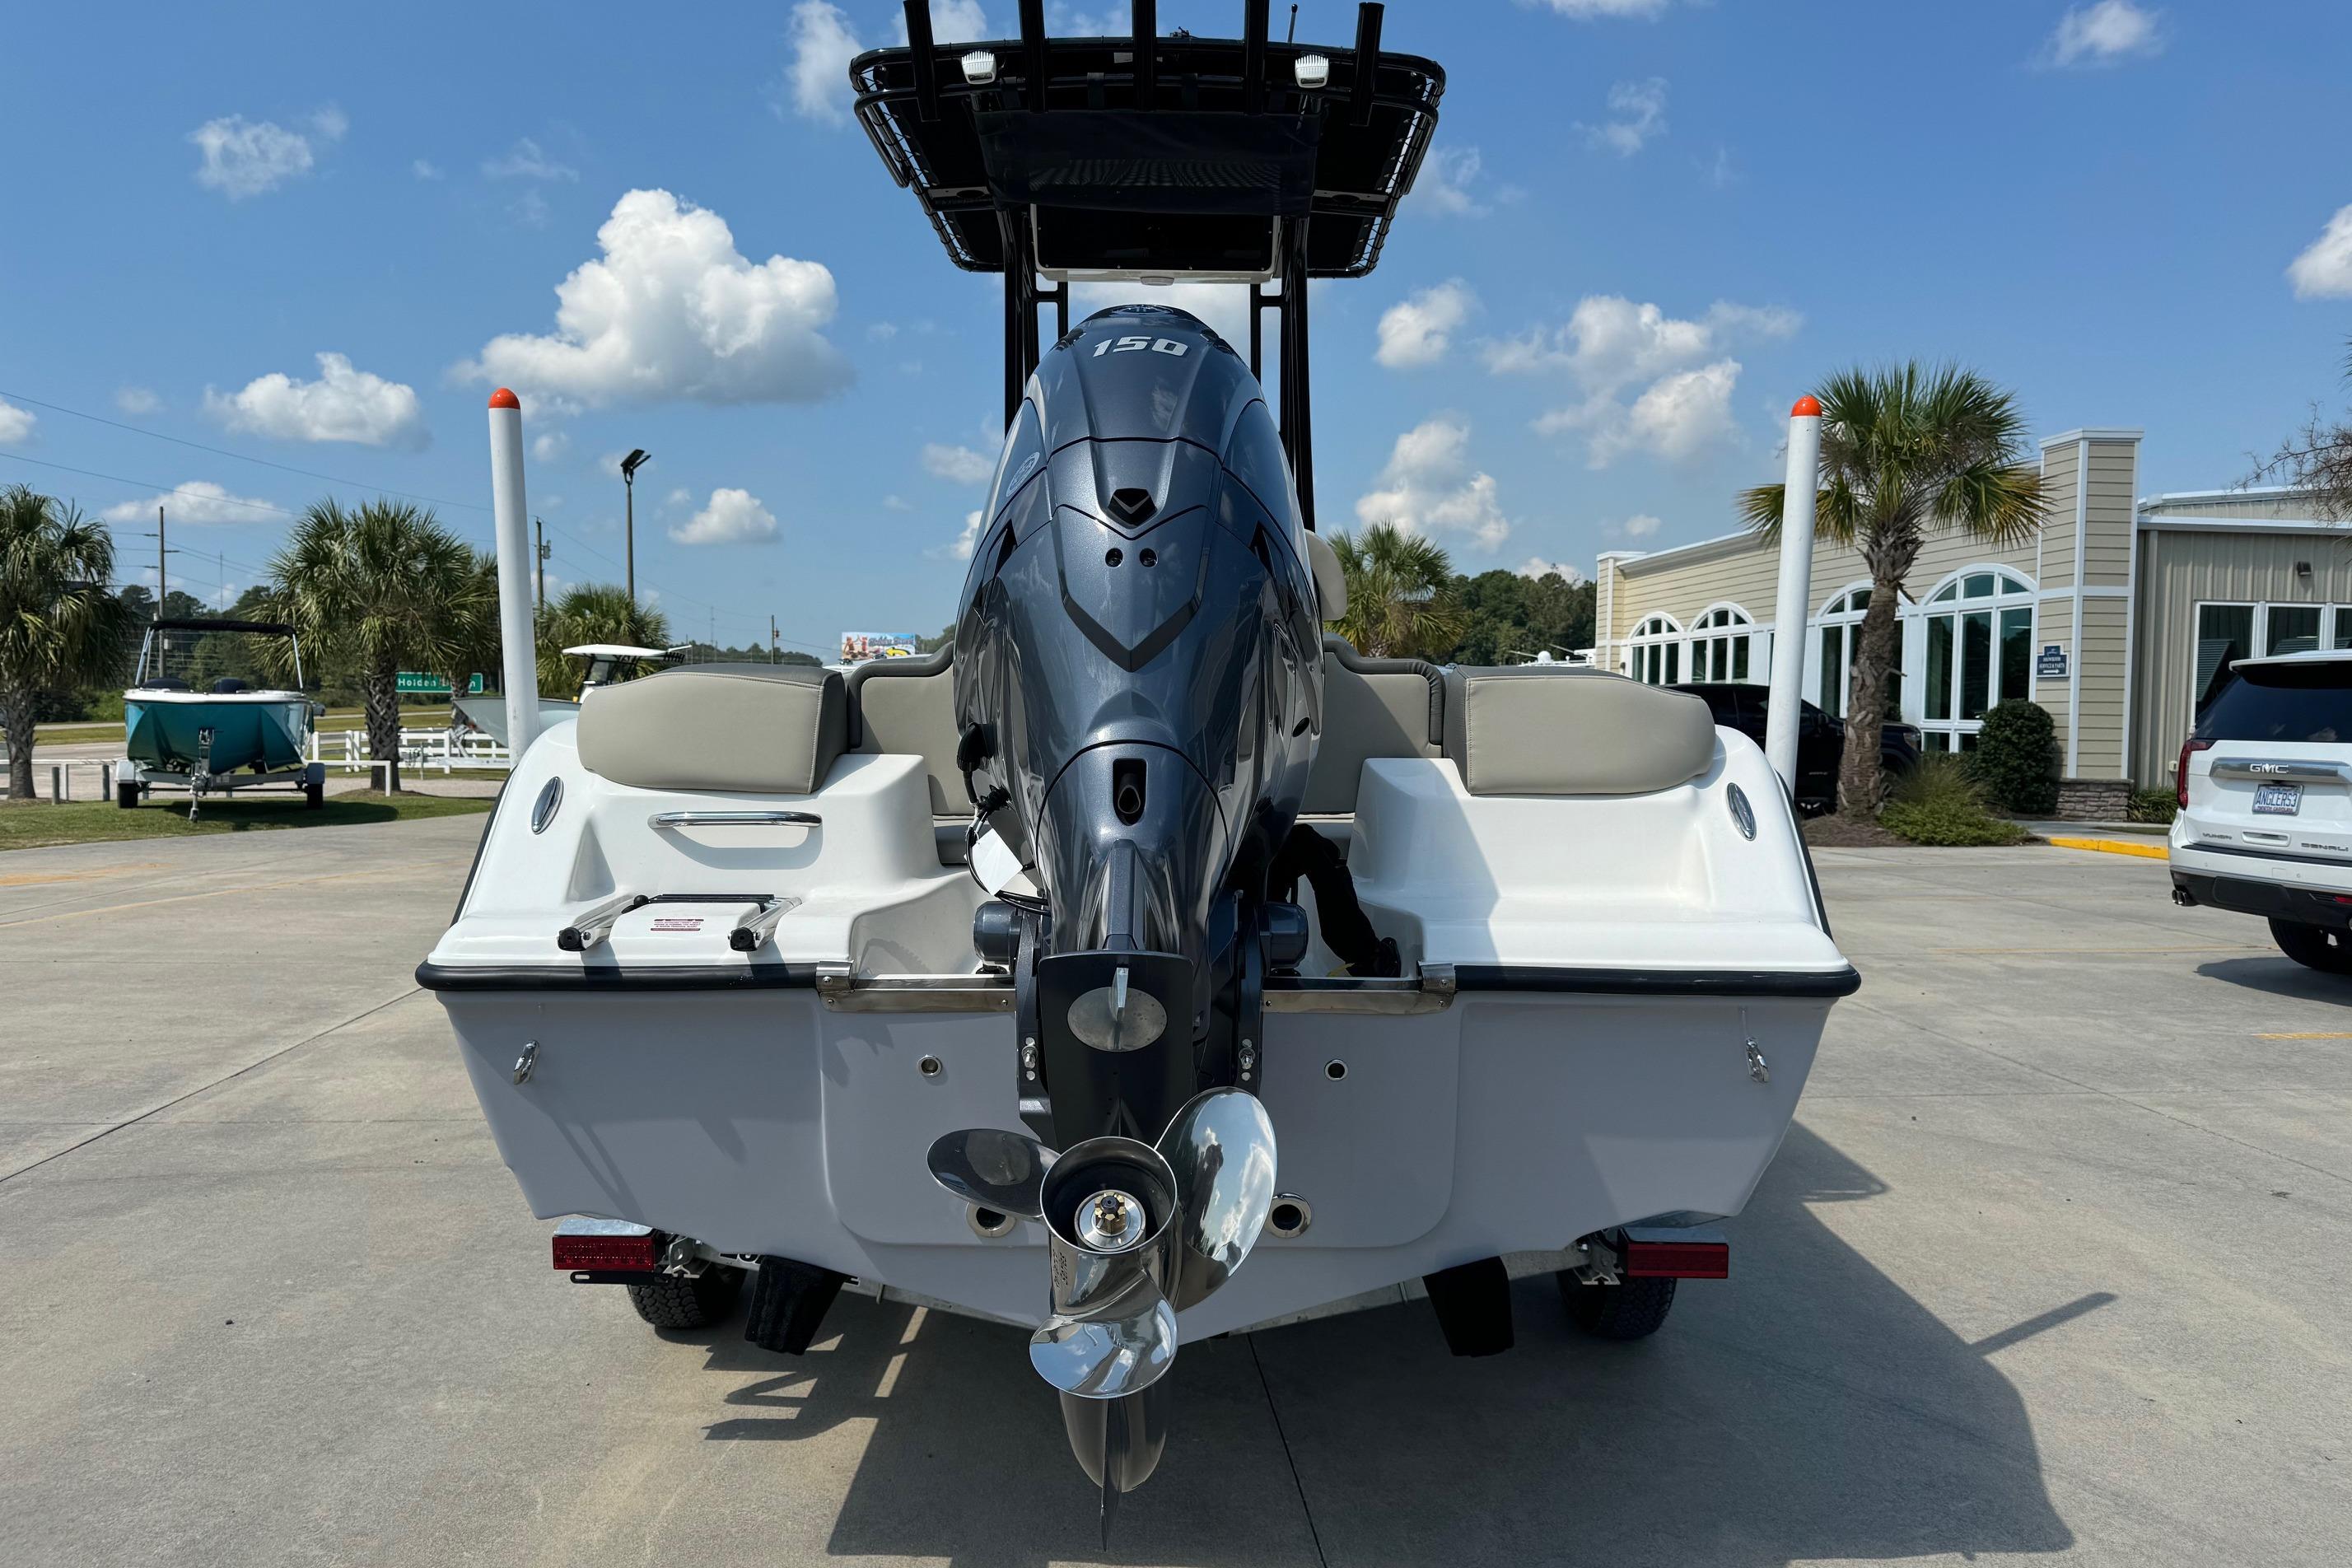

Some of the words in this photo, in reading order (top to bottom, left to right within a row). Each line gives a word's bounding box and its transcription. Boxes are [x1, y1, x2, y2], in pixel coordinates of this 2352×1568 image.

[1093, 336, 1188, 357] 150
[2250, 763, 2289, 773] GMC
[2256, 791, 2297, 807] ANGLERS3
[2301, 842, 2349, 852] DENALI
